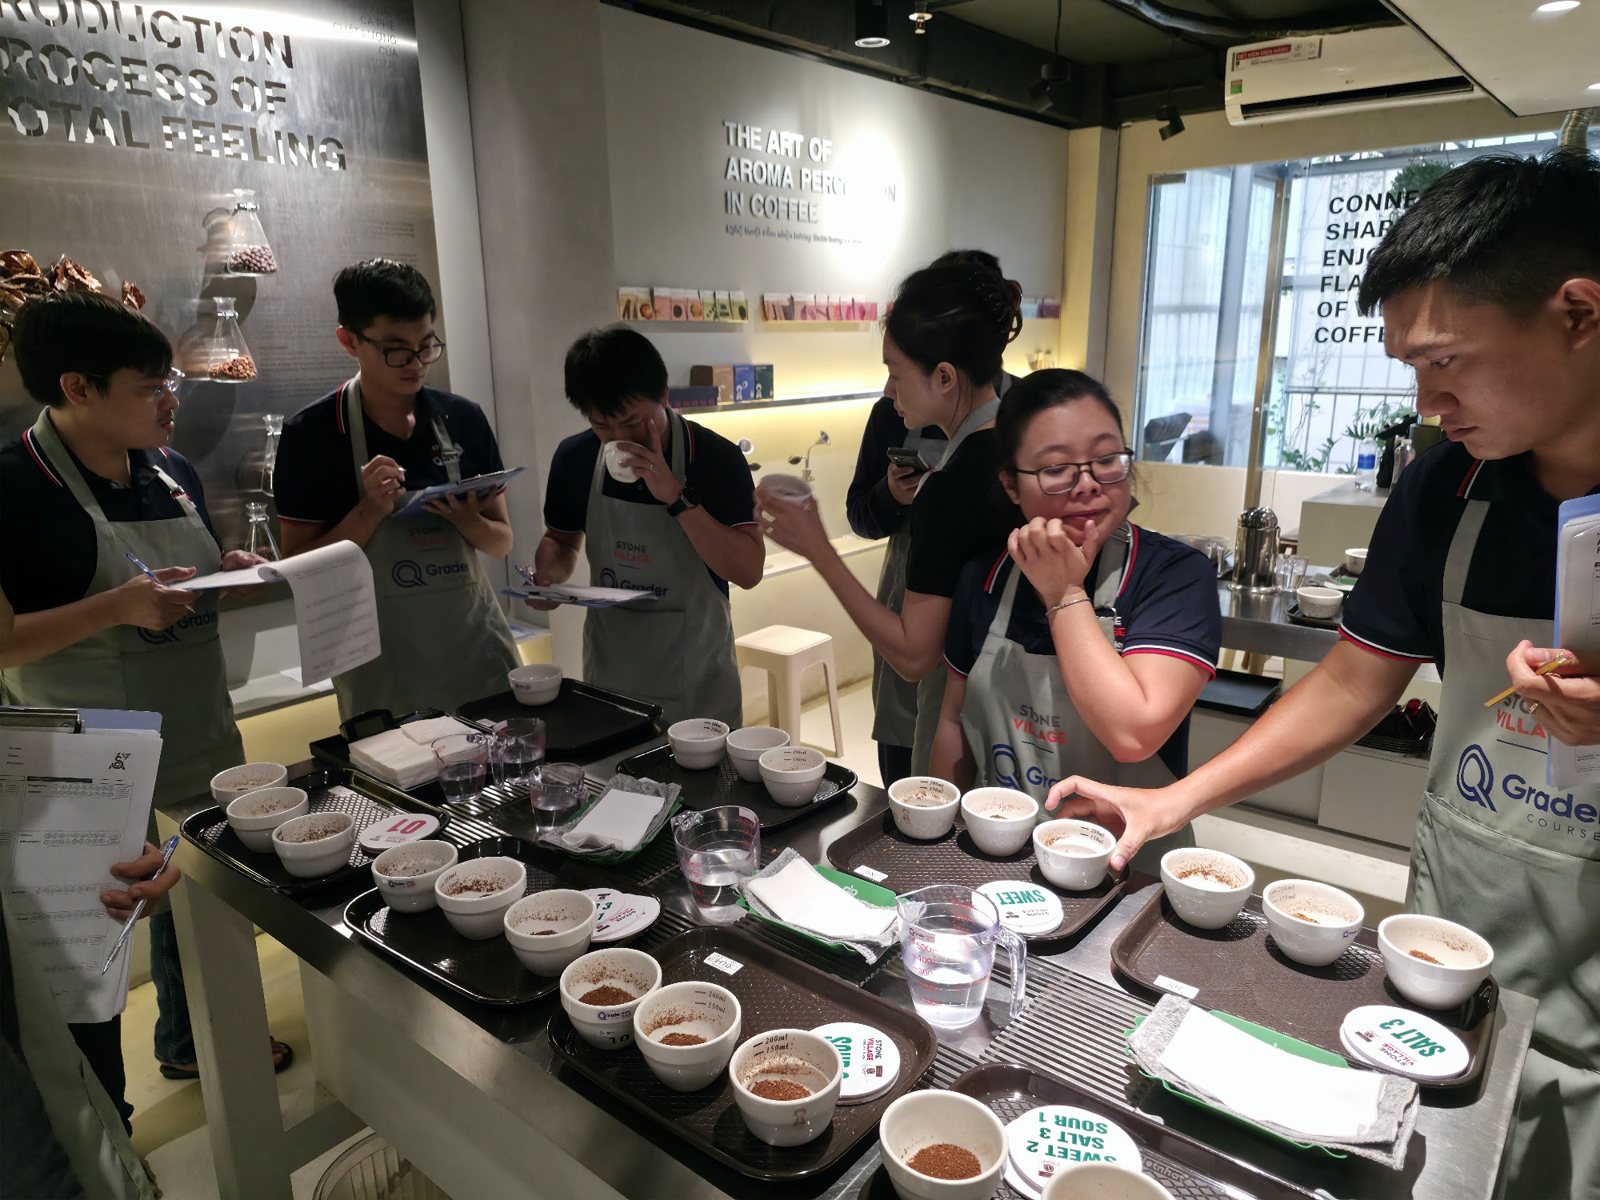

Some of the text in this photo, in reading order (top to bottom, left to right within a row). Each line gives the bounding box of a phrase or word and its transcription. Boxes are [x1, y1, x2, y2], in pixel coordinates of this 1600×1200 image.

[231, 75, 287, 115] OF
[161, 116, 347, 171] FEELING
[723, 120, 833, 163] THE ART OF
[724, 156, 794, 189] AROMA
[724, 190, 819, 224] IN COFFEE
[1317, 301, 1348, 318] OF
[1456, 743, 1600, 825] Q Grade
[1526, 813, 1600, 841] COURSE
[995, 889, 1047, 906] SWEET
[707, 1001, 727, 1014] 150ml
[708, 990, 727, 1003] 200ml
[764, 1033, 789, 1044] 200ml
[765, 1043, 790, 1053] 150ml
[866, 1037, 875, 1061] VILLAGE
[874, 1039, 883, 1060] STONE
[1379, 1018, 1447, 1058] SALT 3
[1038, 1111, 1109, 1135] SOUR 1
[1026, 1139, 1039, 1154] 2
[1039, 1127, 1105, 1150] SALT 3
